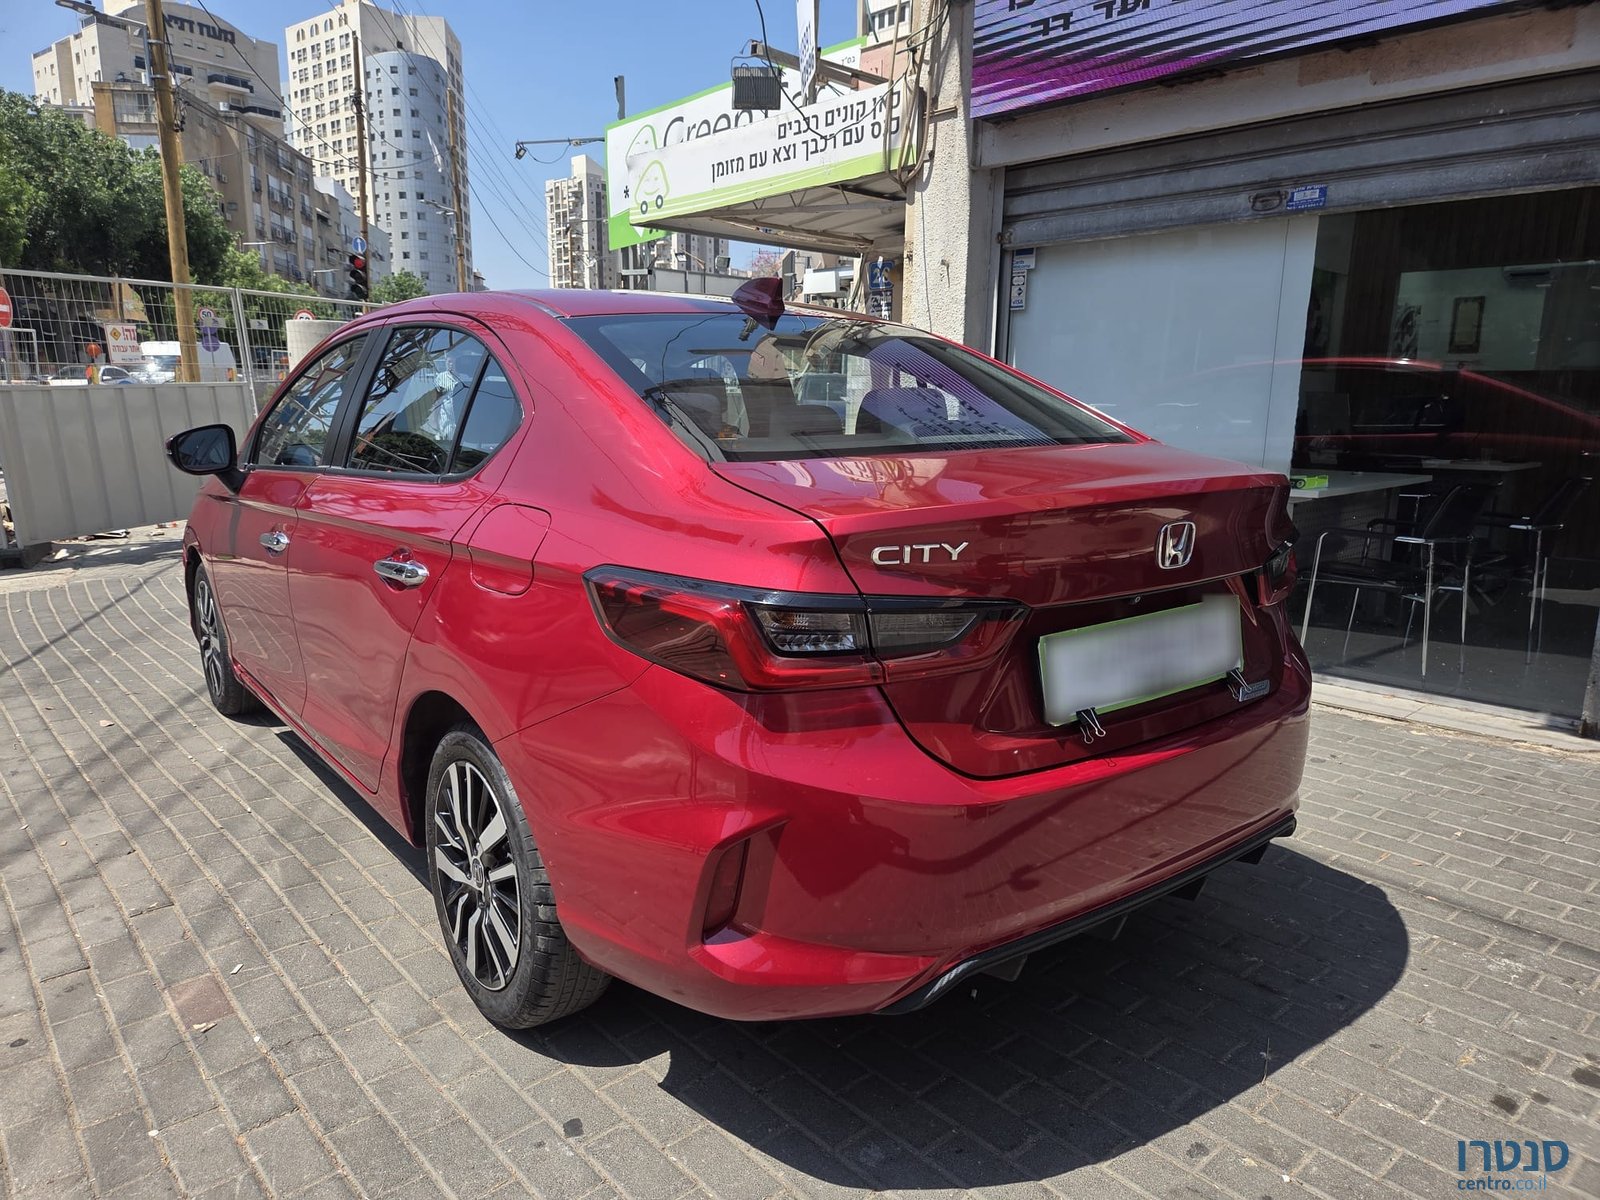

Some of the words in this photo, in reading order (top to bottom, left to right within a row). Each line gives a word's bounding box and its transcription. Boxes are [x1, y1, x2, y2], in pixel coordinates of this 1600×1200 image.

[825, 100, 866, 128] קונים
[778, 114, 819, 139] רכבים
[843, 125, 864, 146] עם
[871, 116, 900, 139] כס
[750, 150, 767, 168] עם
[773, 142, 796, 164] וצא
[801, 133, 837, 161] רכבך
[712, 156, 744, 183] מזומן
[870, 541, 969, 565] CITY
